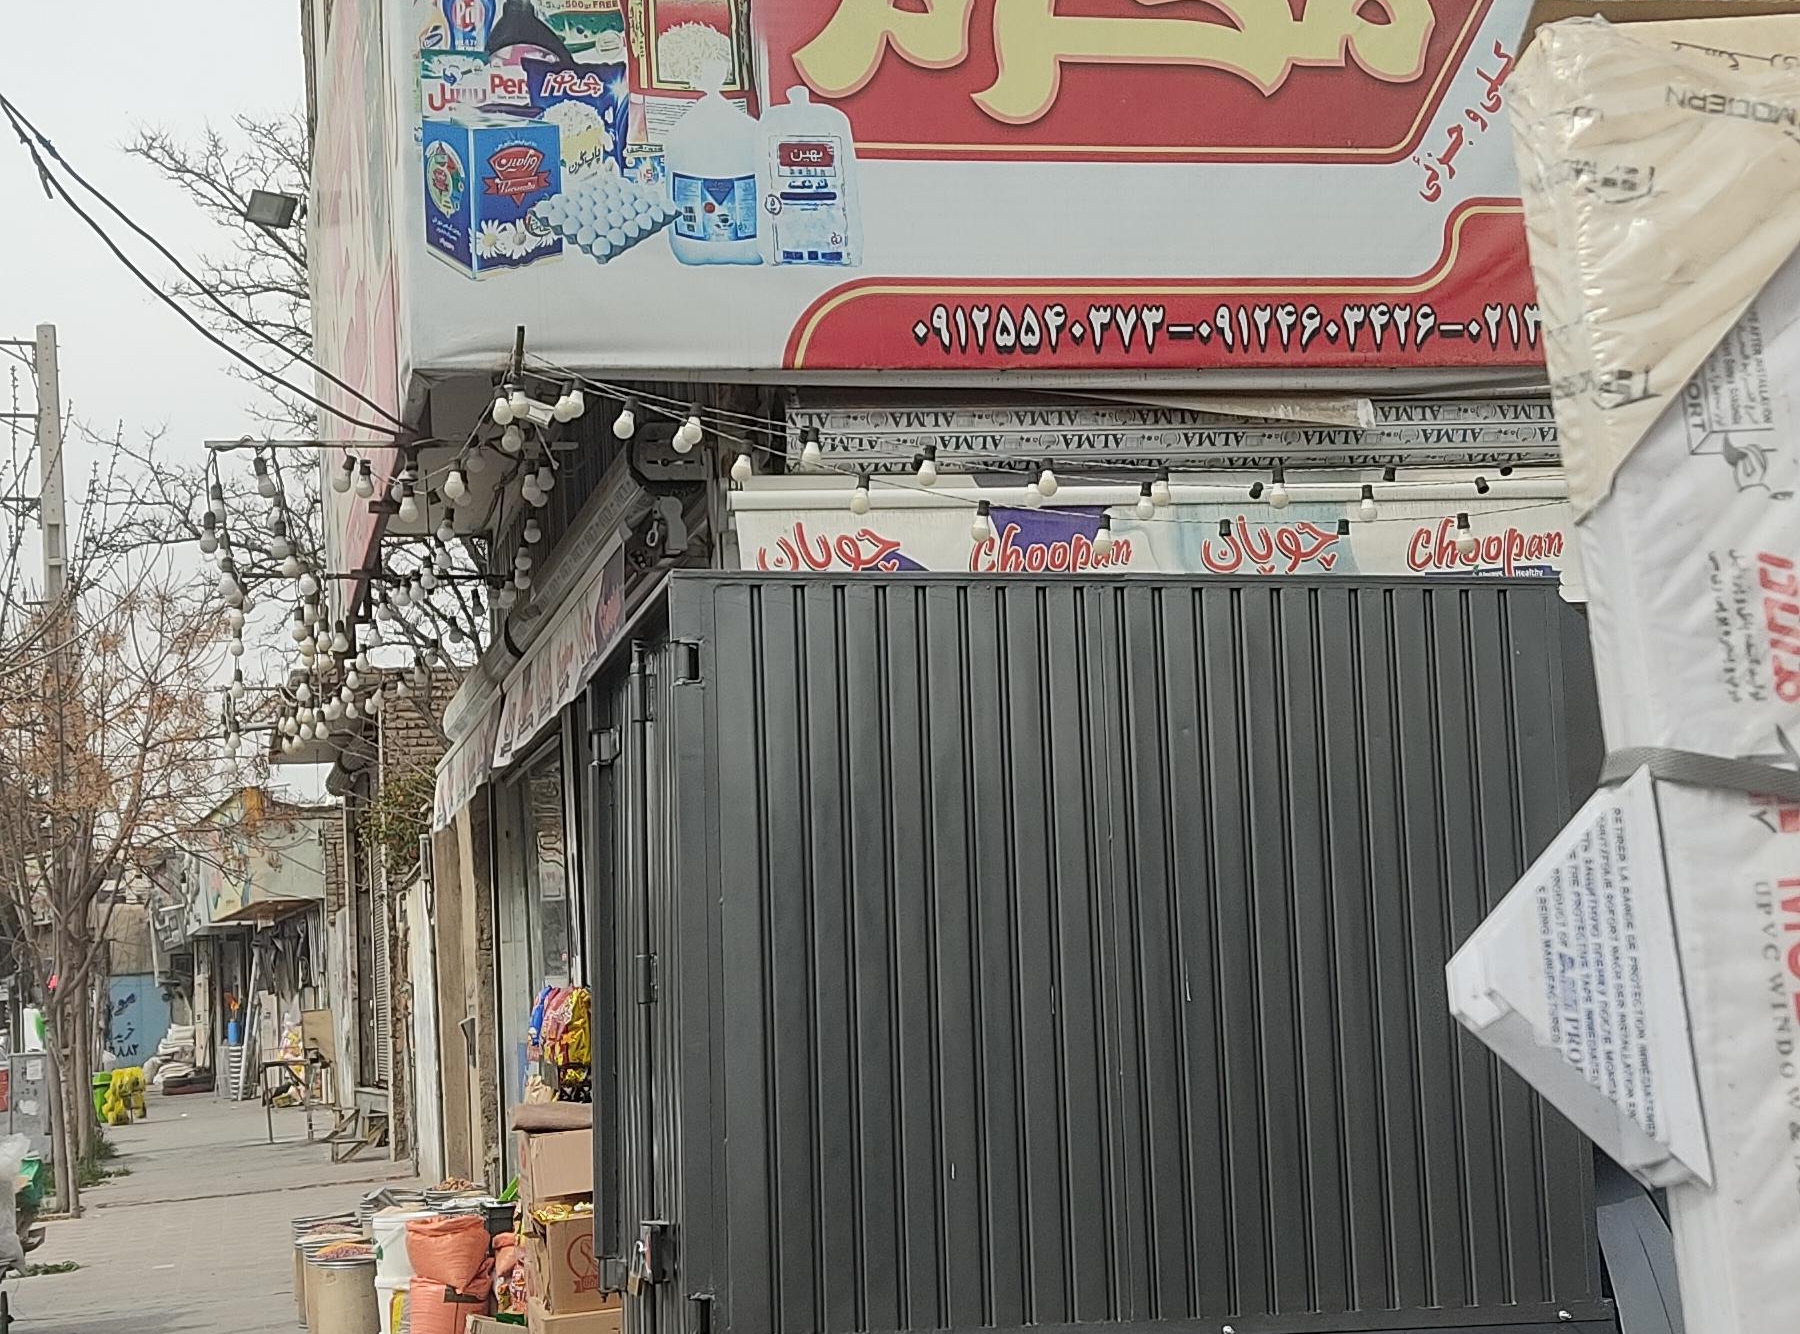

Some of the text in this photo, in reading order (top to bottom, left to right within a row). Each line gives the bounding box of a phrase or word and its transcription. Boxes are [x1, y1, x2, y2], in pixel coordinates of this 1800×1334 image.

[490, 74, 529, 94] Per
[1663, 85, 1798, 125] MODERN
[1413, 39, 1515, 202] کلی و جزئی
[791, 149, 823, 162] بهین
[887, 411, 954, 426] ALMA
[1014, 411, 1078, 426] ALMA
[1136, 409, 1199, 424] ALMA
[1378, 404, 1440, 421] ALMA
[939, 434, 1003, 450] ALMA
[1060, 433, 1124, 448] ALMA
[1182, 431, 1245, 446] ALMA
[1302, 430, 1364, 444] ALMA
[1420, 428, 1482, 442] ALMA
[1202, 515, 1341, 574] چوپان
[1409, 517, 1564, 576] Choopan
[1753, 879, 1781, 963] UPVC
[1765, 971, 1800, 1110] WINDOW
